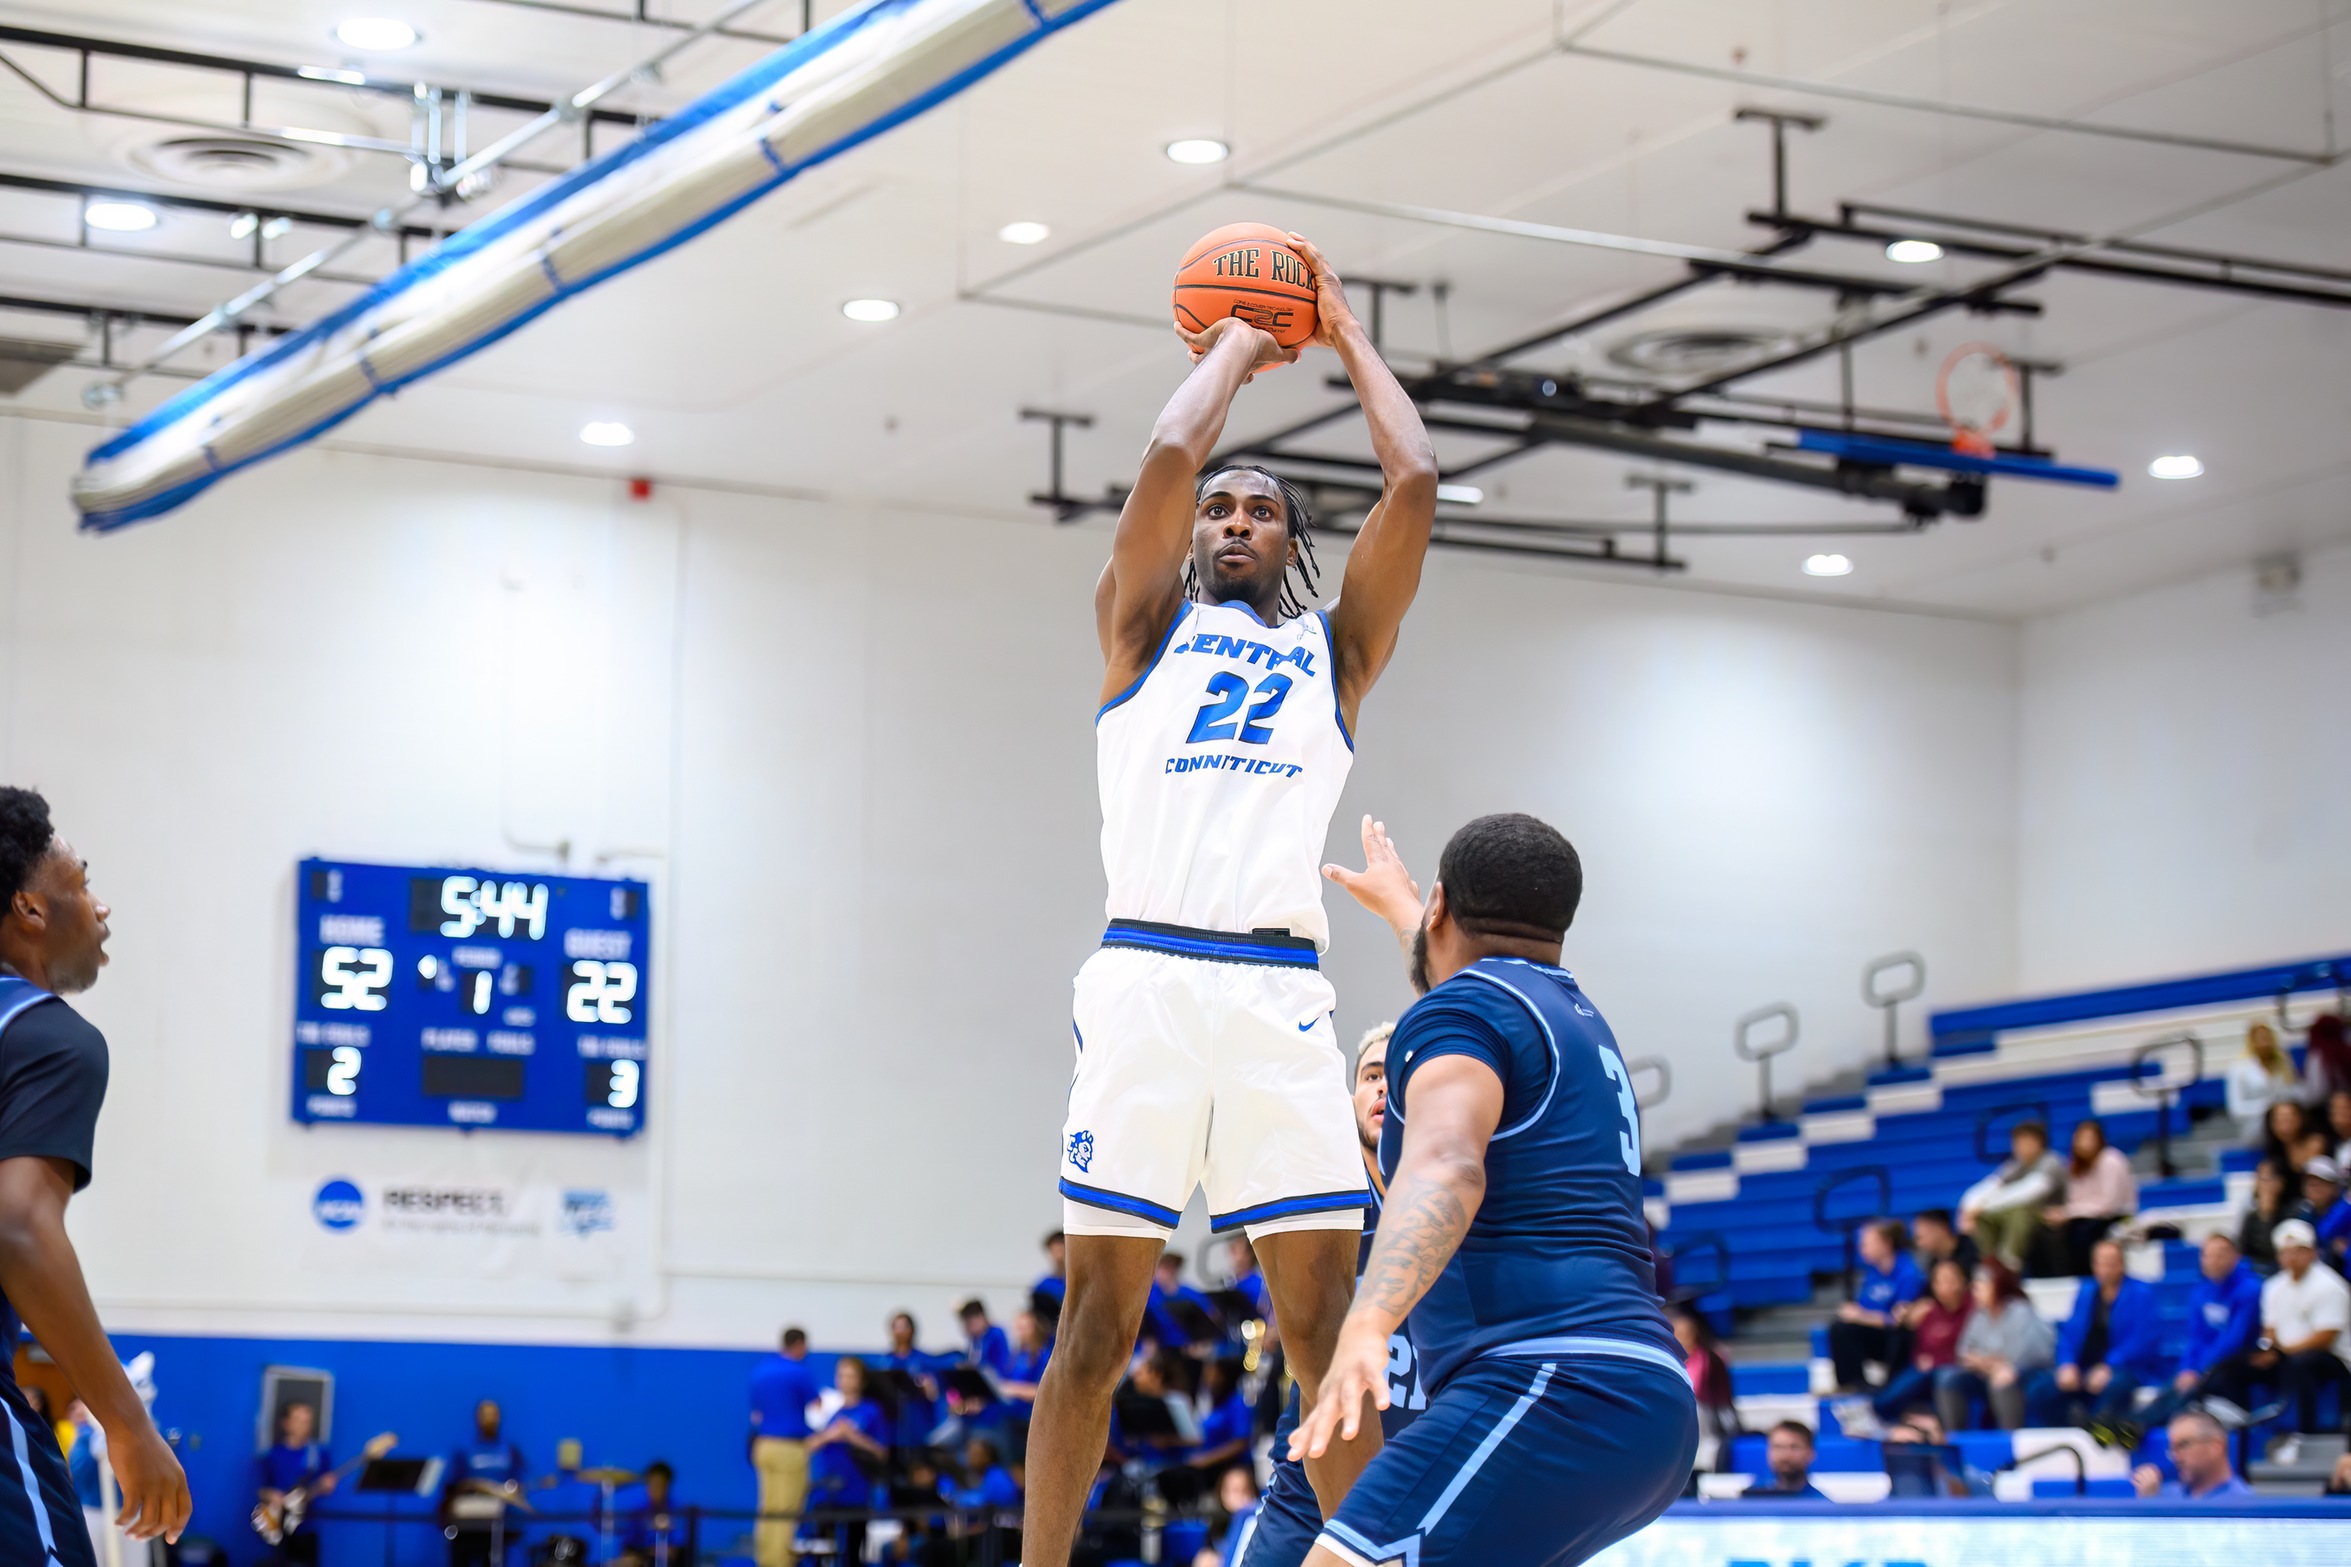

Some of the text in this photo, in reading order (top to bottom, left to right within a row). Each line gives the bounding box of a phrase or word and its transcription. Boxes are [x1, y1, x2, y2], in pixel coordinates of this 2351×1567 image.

[1213, 249, 1259, 278] THE
[1231, 304, 1294, 328] C2C
[1186, 671, 1293, 745] 22
[440, 876, 549, 940] 5:44
[321, 946, 393, 1011] 52
[473, 970, 493, 1015] 1
[566, 960, 637, 1024] 22
[327, 1046, 362, 1096] 2
[608, 1059, 640, 1108] 3
[1599, 1044, 1641, 1178] 3
